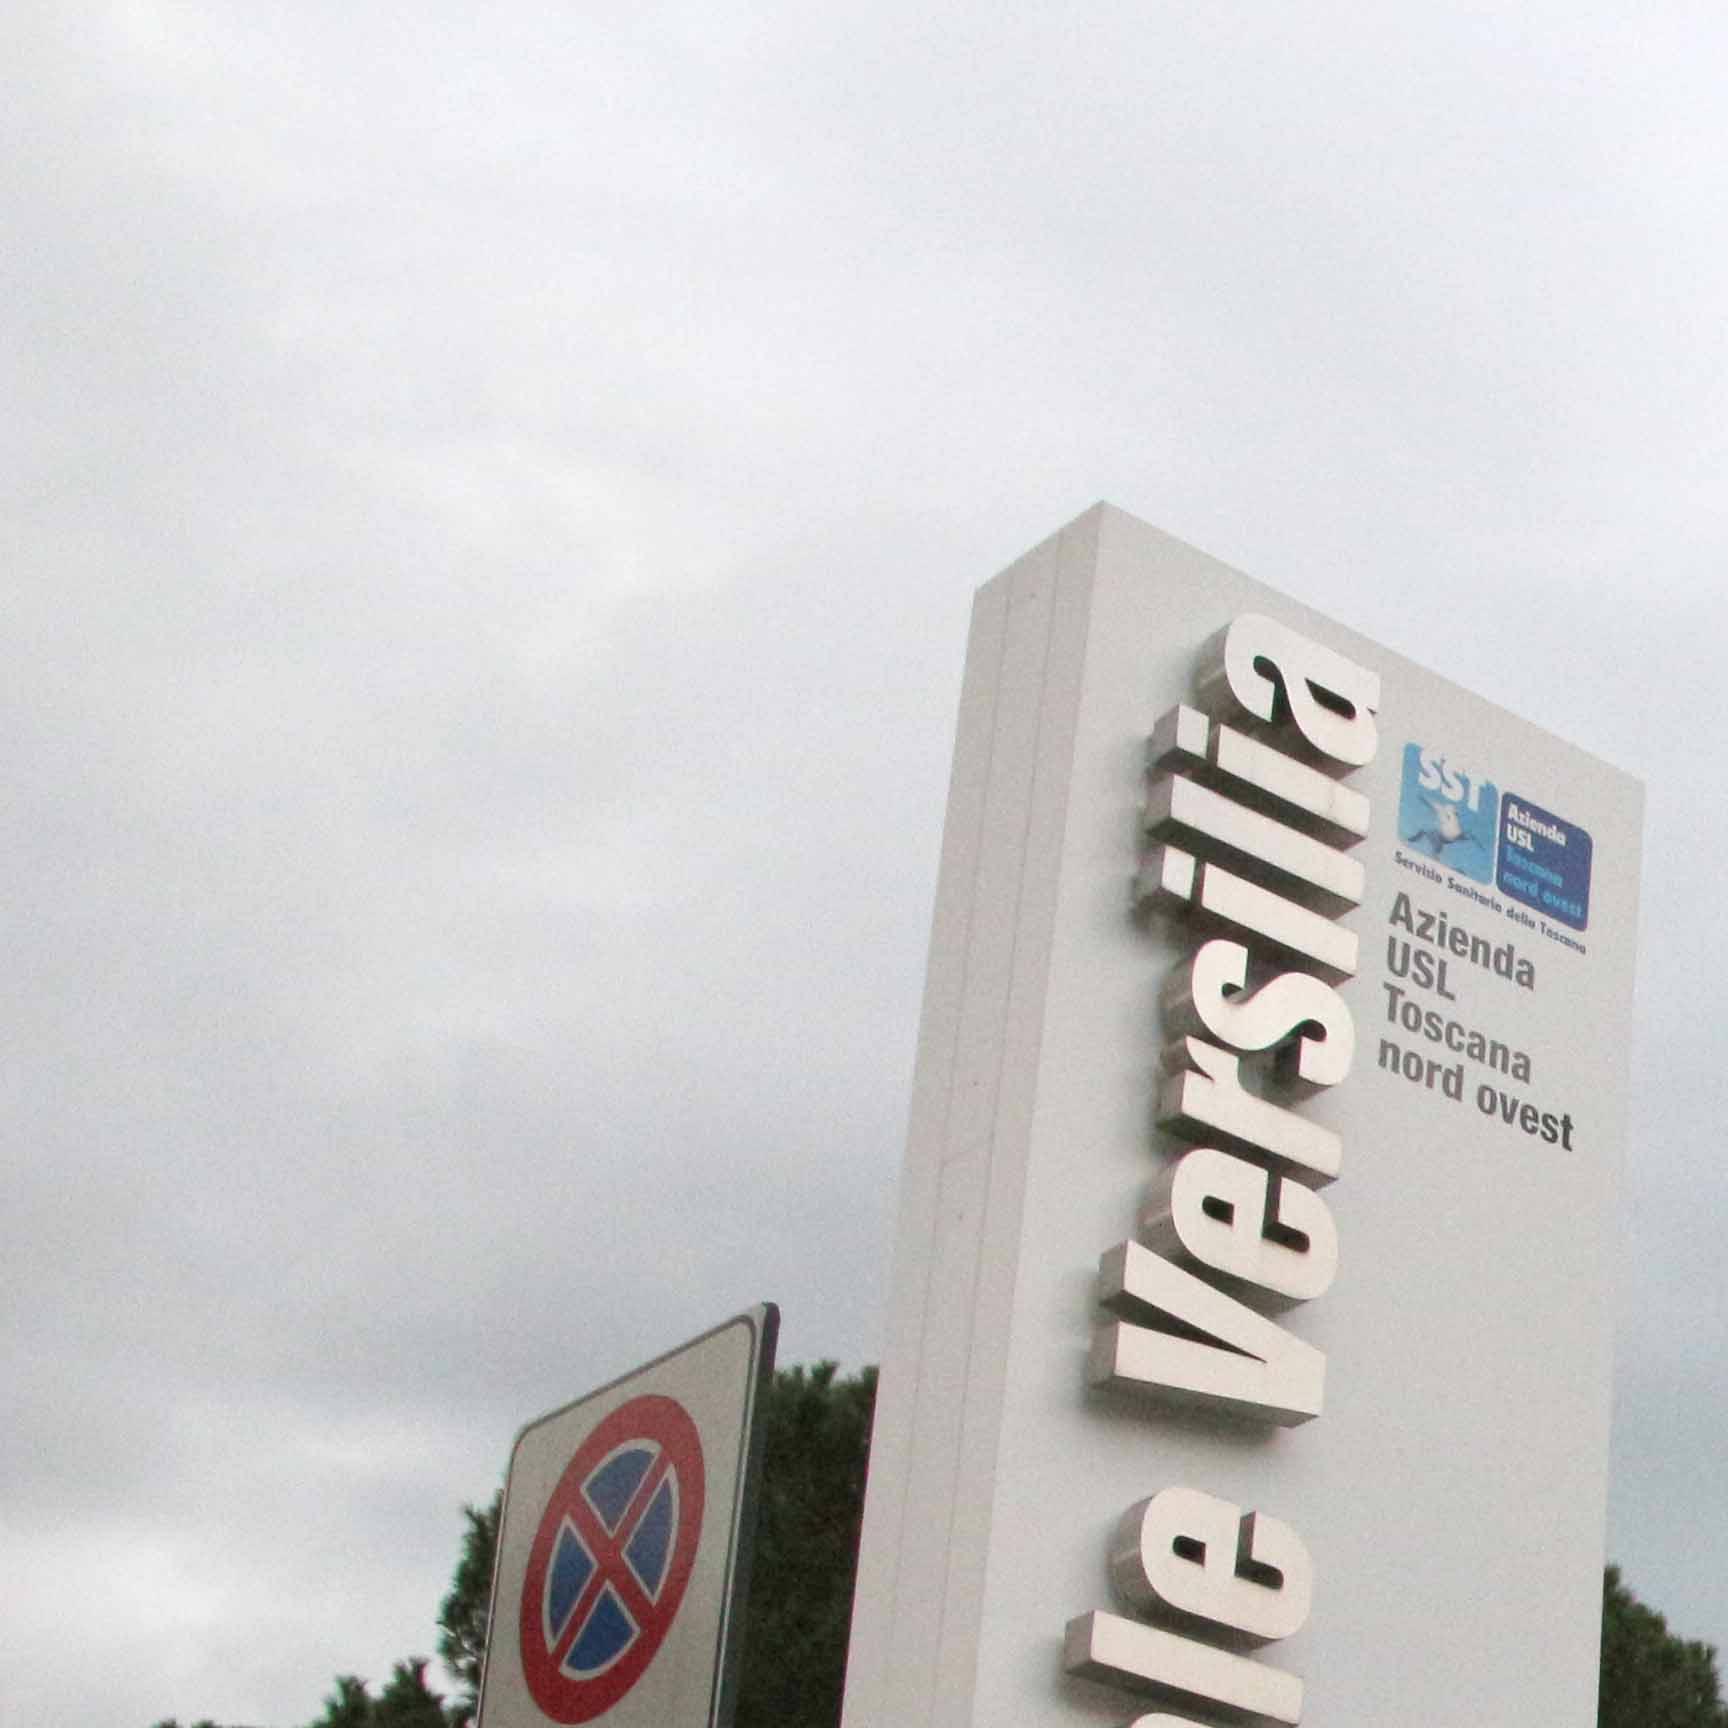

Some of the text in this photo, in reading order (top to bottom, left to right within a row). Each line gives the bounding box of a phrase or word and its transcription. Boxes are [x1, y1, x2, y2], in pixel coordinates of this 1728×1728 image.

[1506, 823, 1535, 852] USL
[1507, 801, 1567, 848] Azienda
[1388, 891, 1536, 992] Azienda
[1395, 851, 1443, 885] Servizio
[1448, 878, 1502, 914] Sanitario
[1540, 922, 1587, 956] Toscana
[1387, 935, 1457, 1002] USL
[1096, 612, 1381, 1428] Versilia
[1383, 981, 1532, 1085] Toscana
[1378, 1038, 1575, 1153] nord ovest
